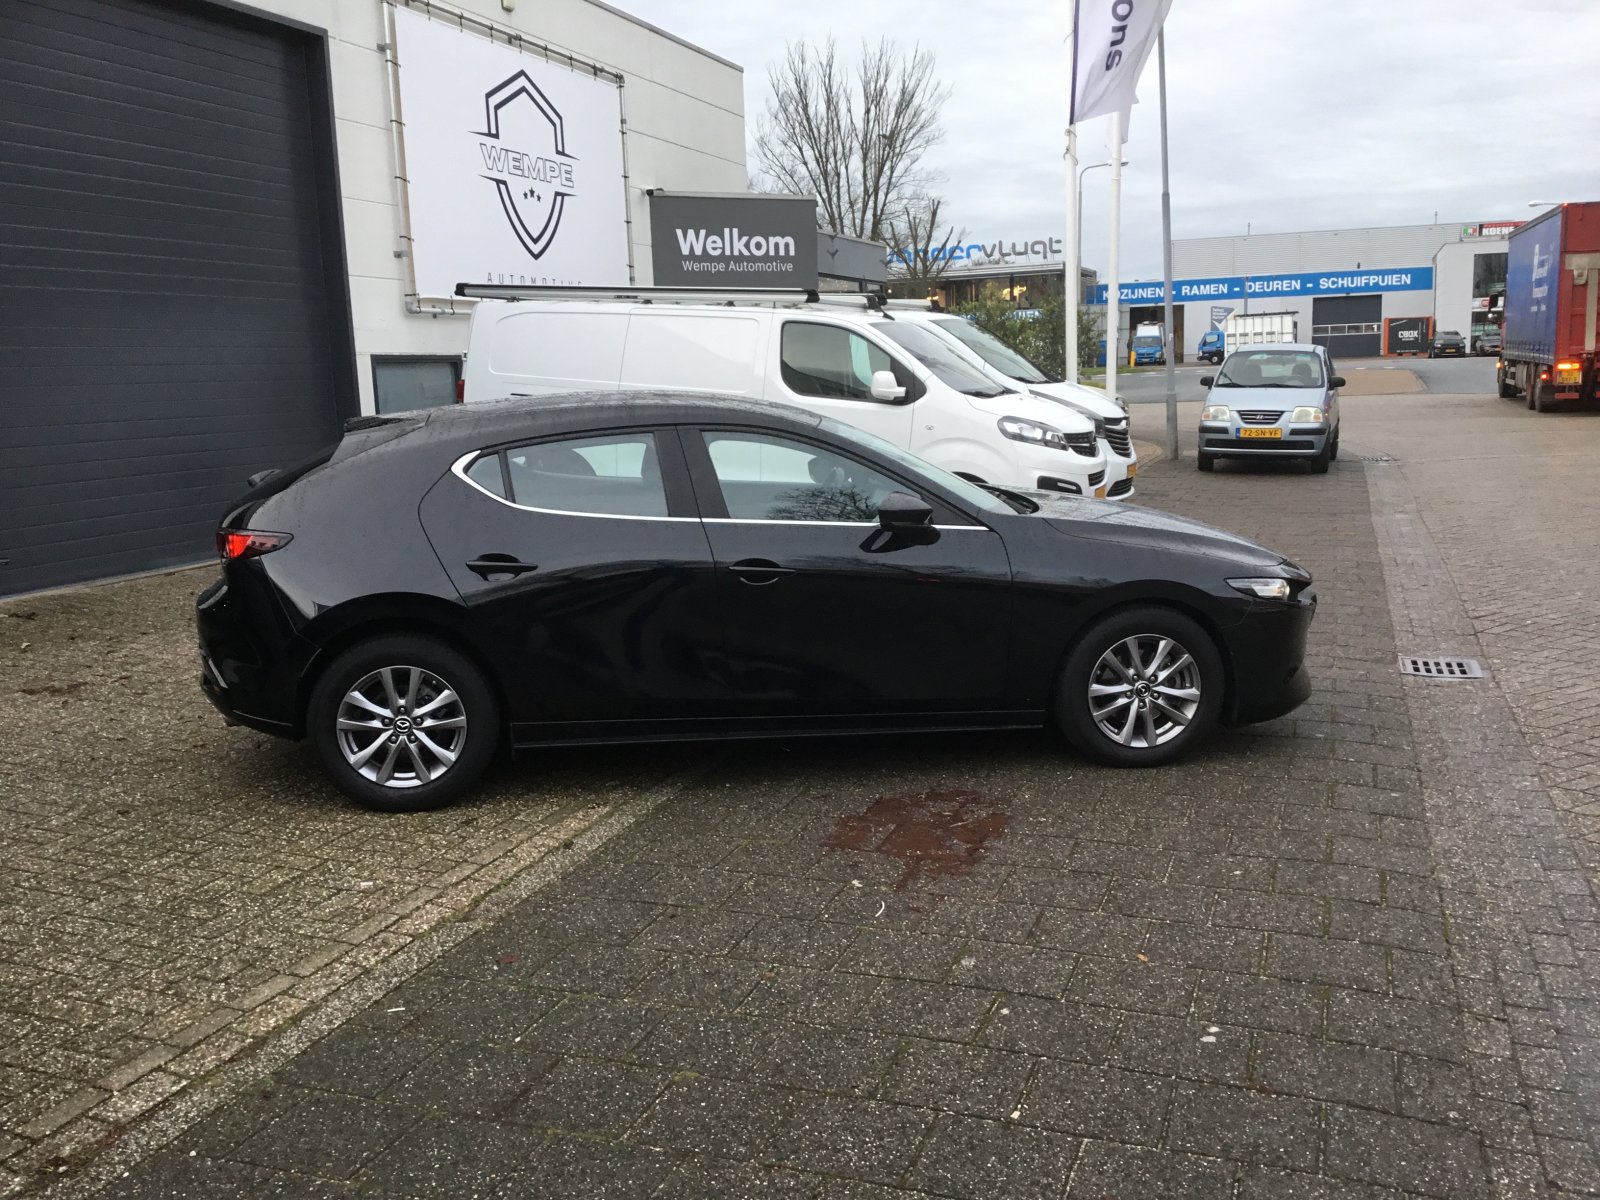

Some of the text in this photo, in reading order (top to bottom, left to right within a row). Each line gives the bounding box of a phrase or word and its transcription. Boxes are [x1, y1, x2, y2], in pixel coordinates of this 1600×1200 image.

[479, 142, 575, 188] WEMPE
[675, 227, 796, 257] Welkom
[682, 260, 794, 273] Wempe Automotive
[1102, 286, 1165, 301] KZIJNEN
[1181, 283, 1228, 296] RAMEN
[1247, 279, 1301, 293] DEUREN
[1319, 273, 1412, 289] SCHUIFPUIEN
[1242, 429, 1280, 437] 72-SN-VF
